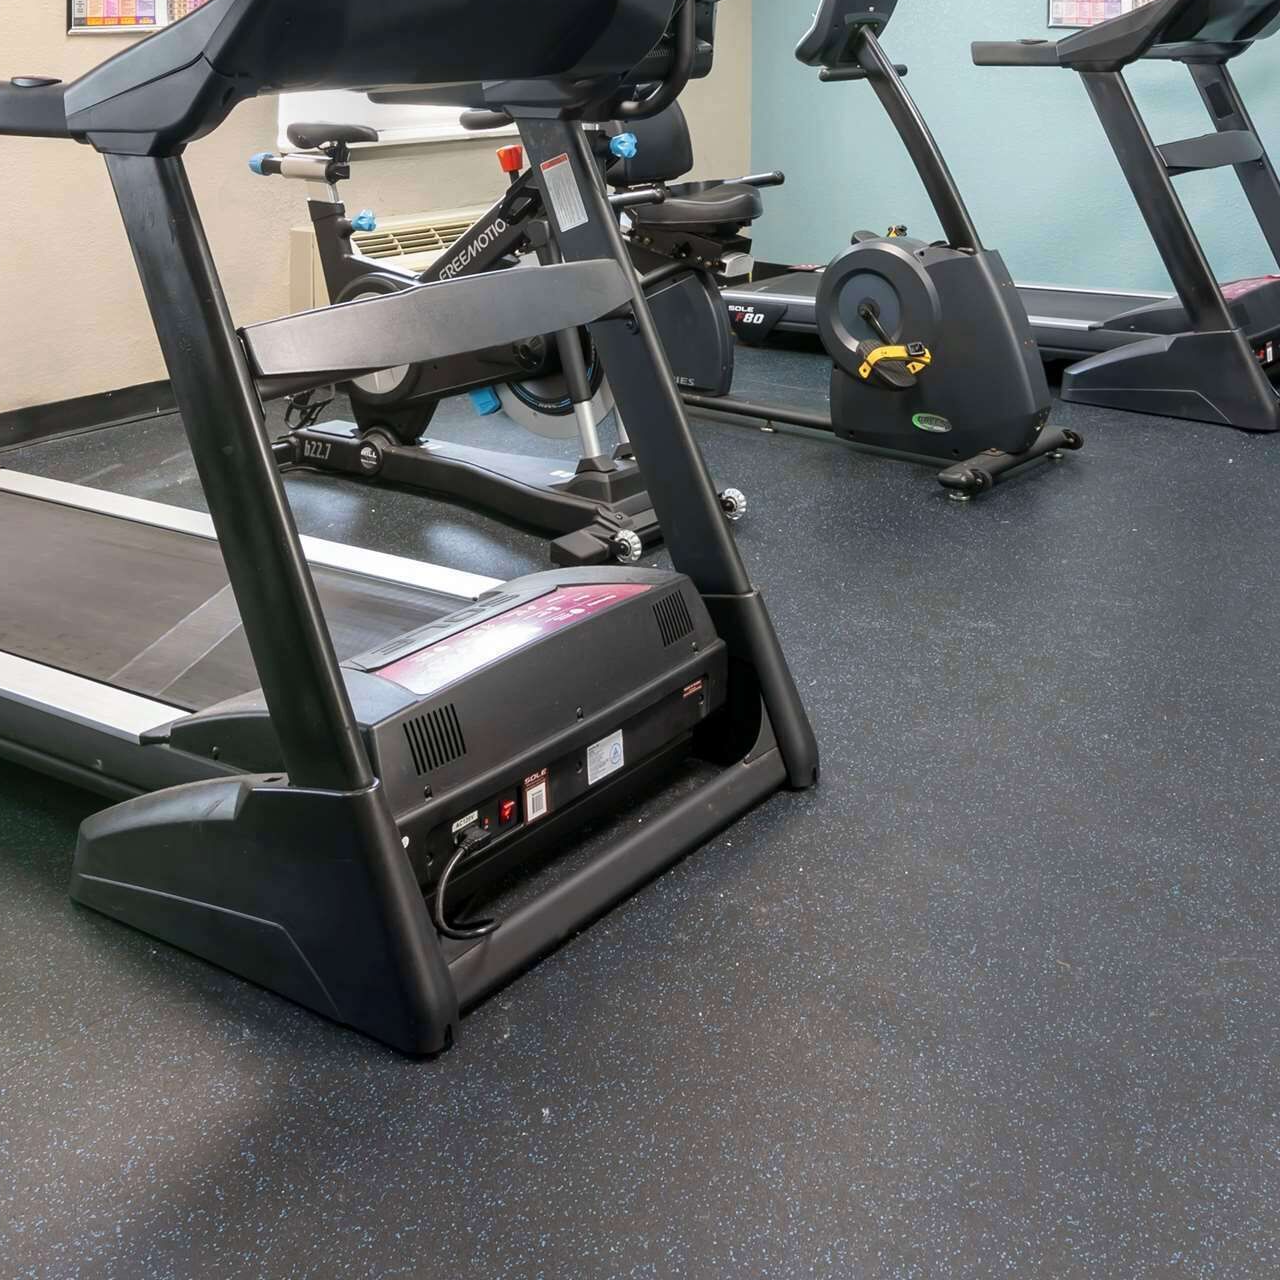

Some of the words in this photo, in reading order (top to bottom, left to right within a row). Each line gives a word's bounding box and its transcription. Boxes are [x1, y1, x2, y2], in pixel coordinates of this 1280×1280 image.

[439, 218, 507, 280] FREEMOTIO
[728, 304, 754, 313] SOLE
[736, 312, 765, 324] F80
[674, 375, 695, 386] IES
[303, 440, 331, 460] b22.7
[524, 767, 548, 784] SOLE
